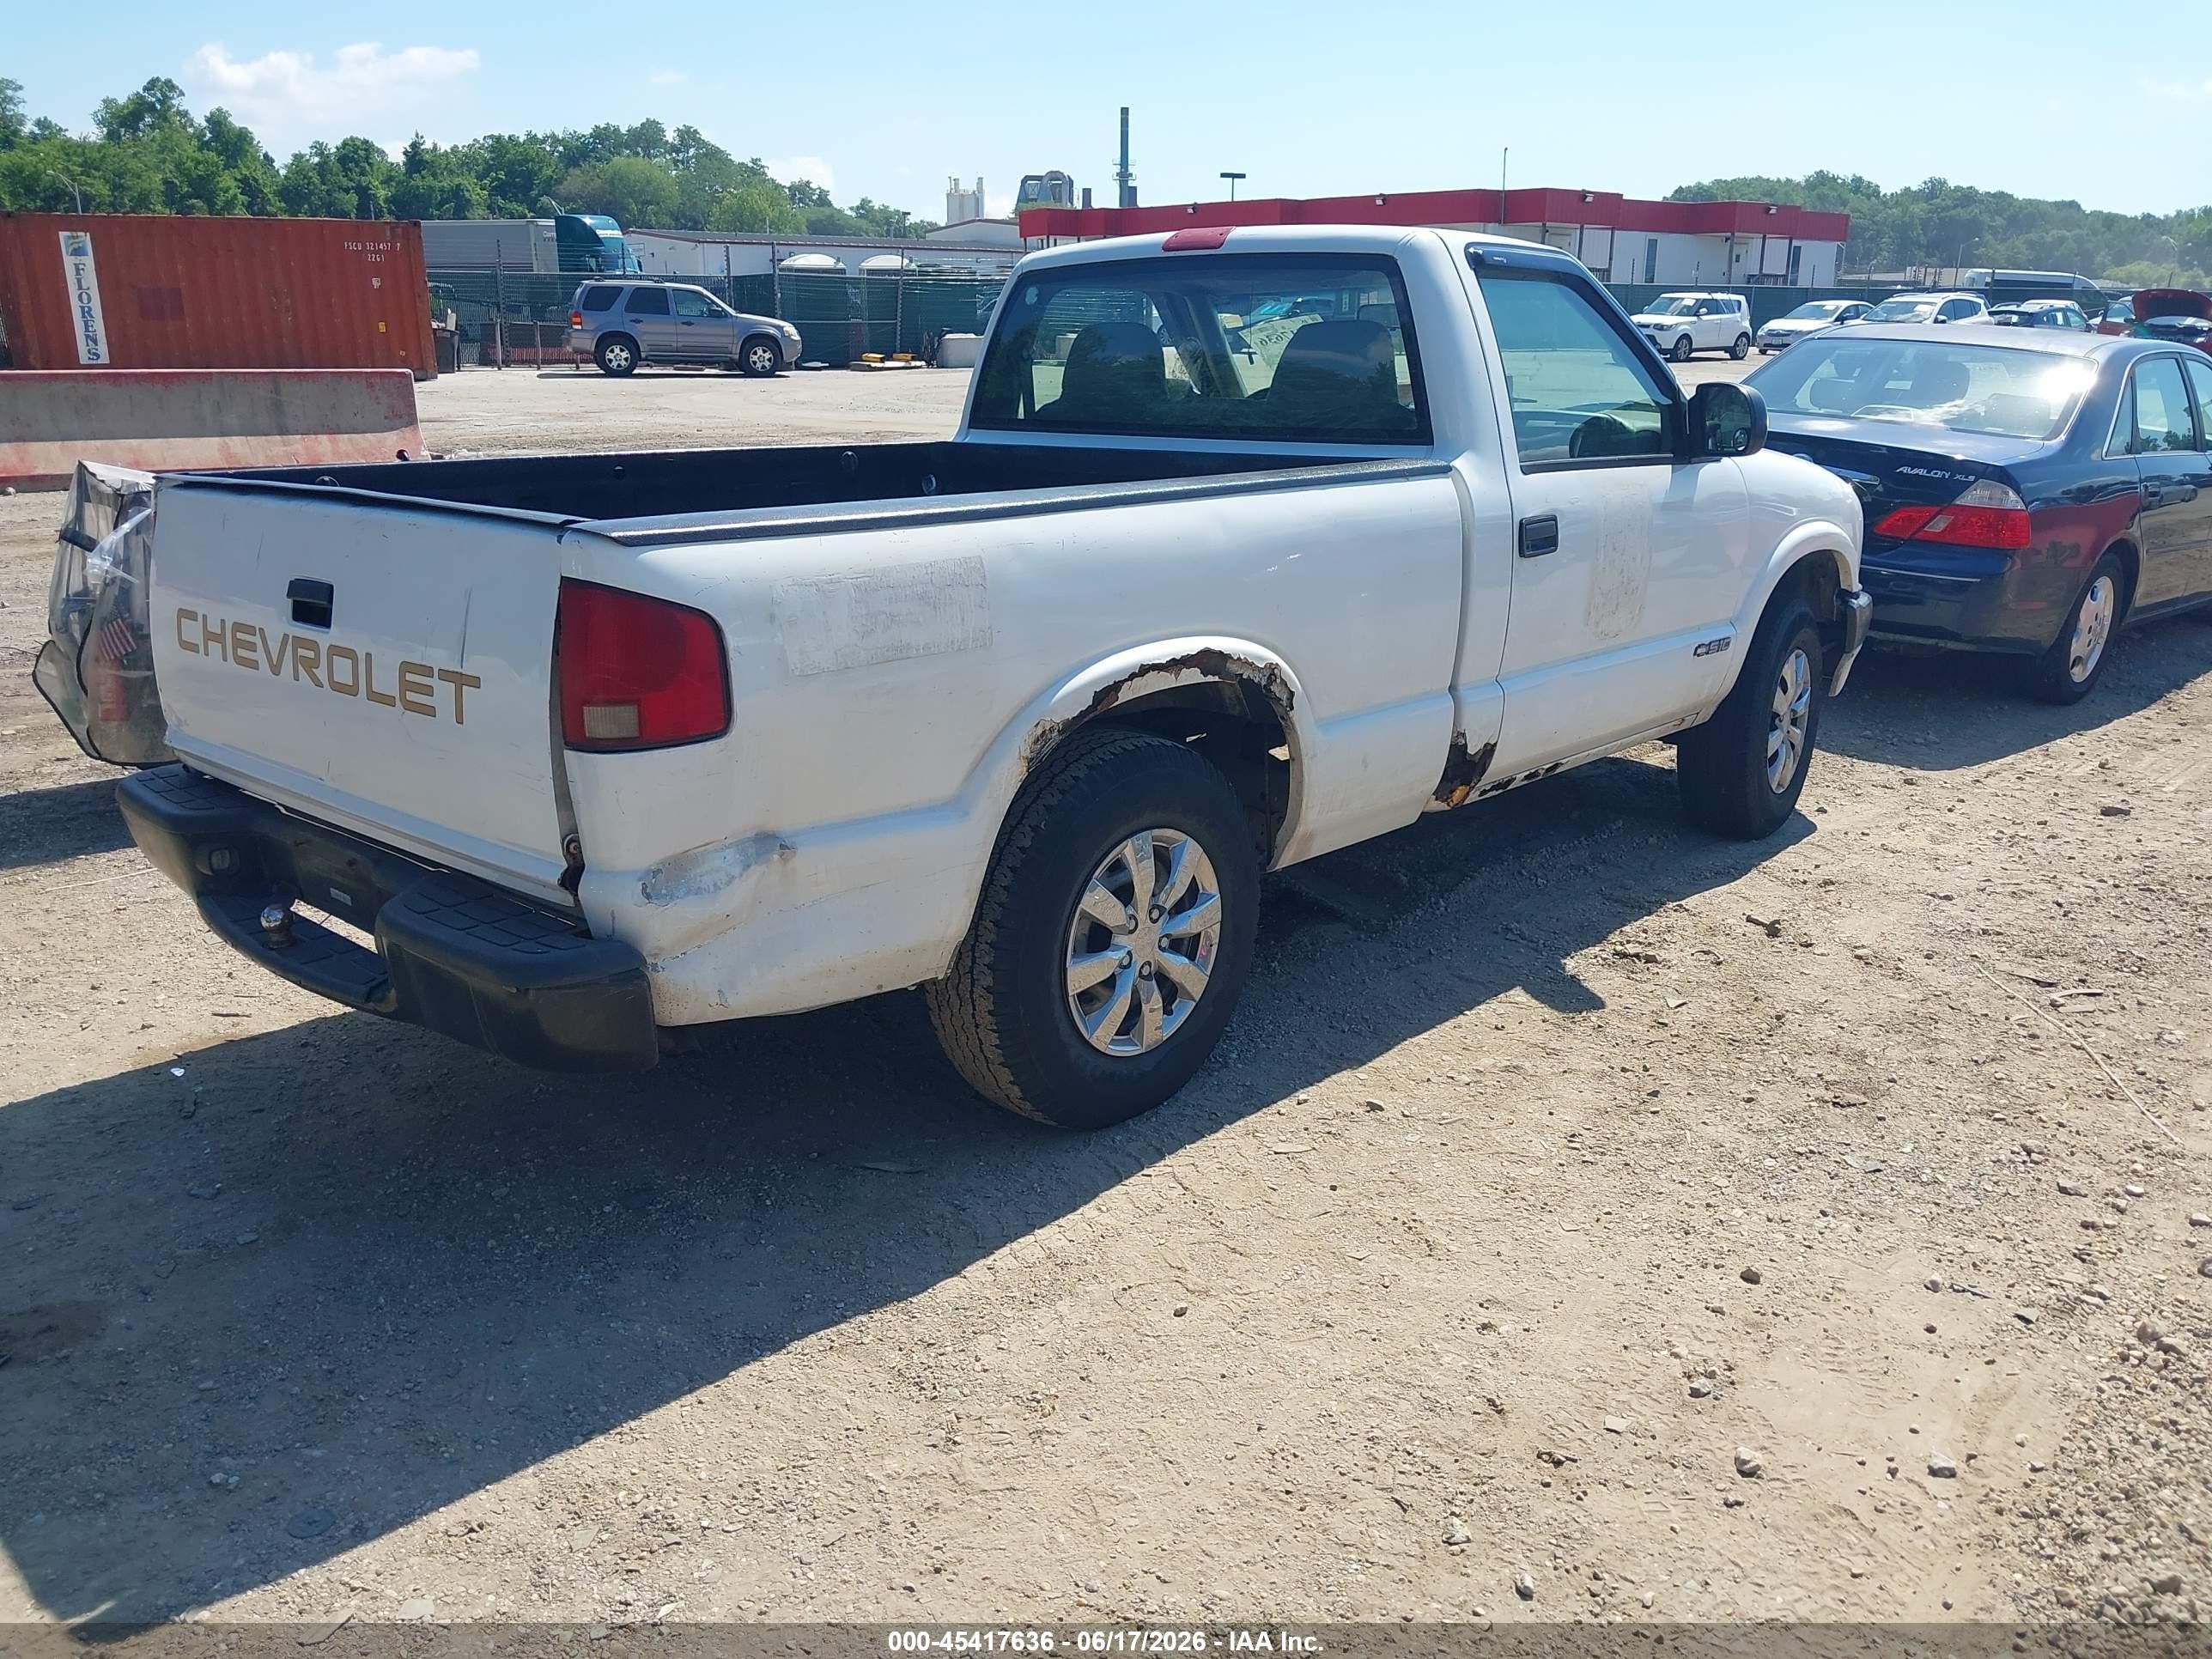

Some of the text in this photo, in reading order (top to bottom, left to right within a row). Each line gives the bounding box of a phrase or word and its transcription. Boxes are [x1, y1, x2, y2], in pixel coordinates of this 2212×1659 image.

[344, 242, 362, 251] FSCU
[366, 242, 391, 252] 321457
[73, 263, 100, 362] FLORENS
[1895, 466, 1951, 479] AVALON
[176, 607, 482, 726] CHEVROLET
